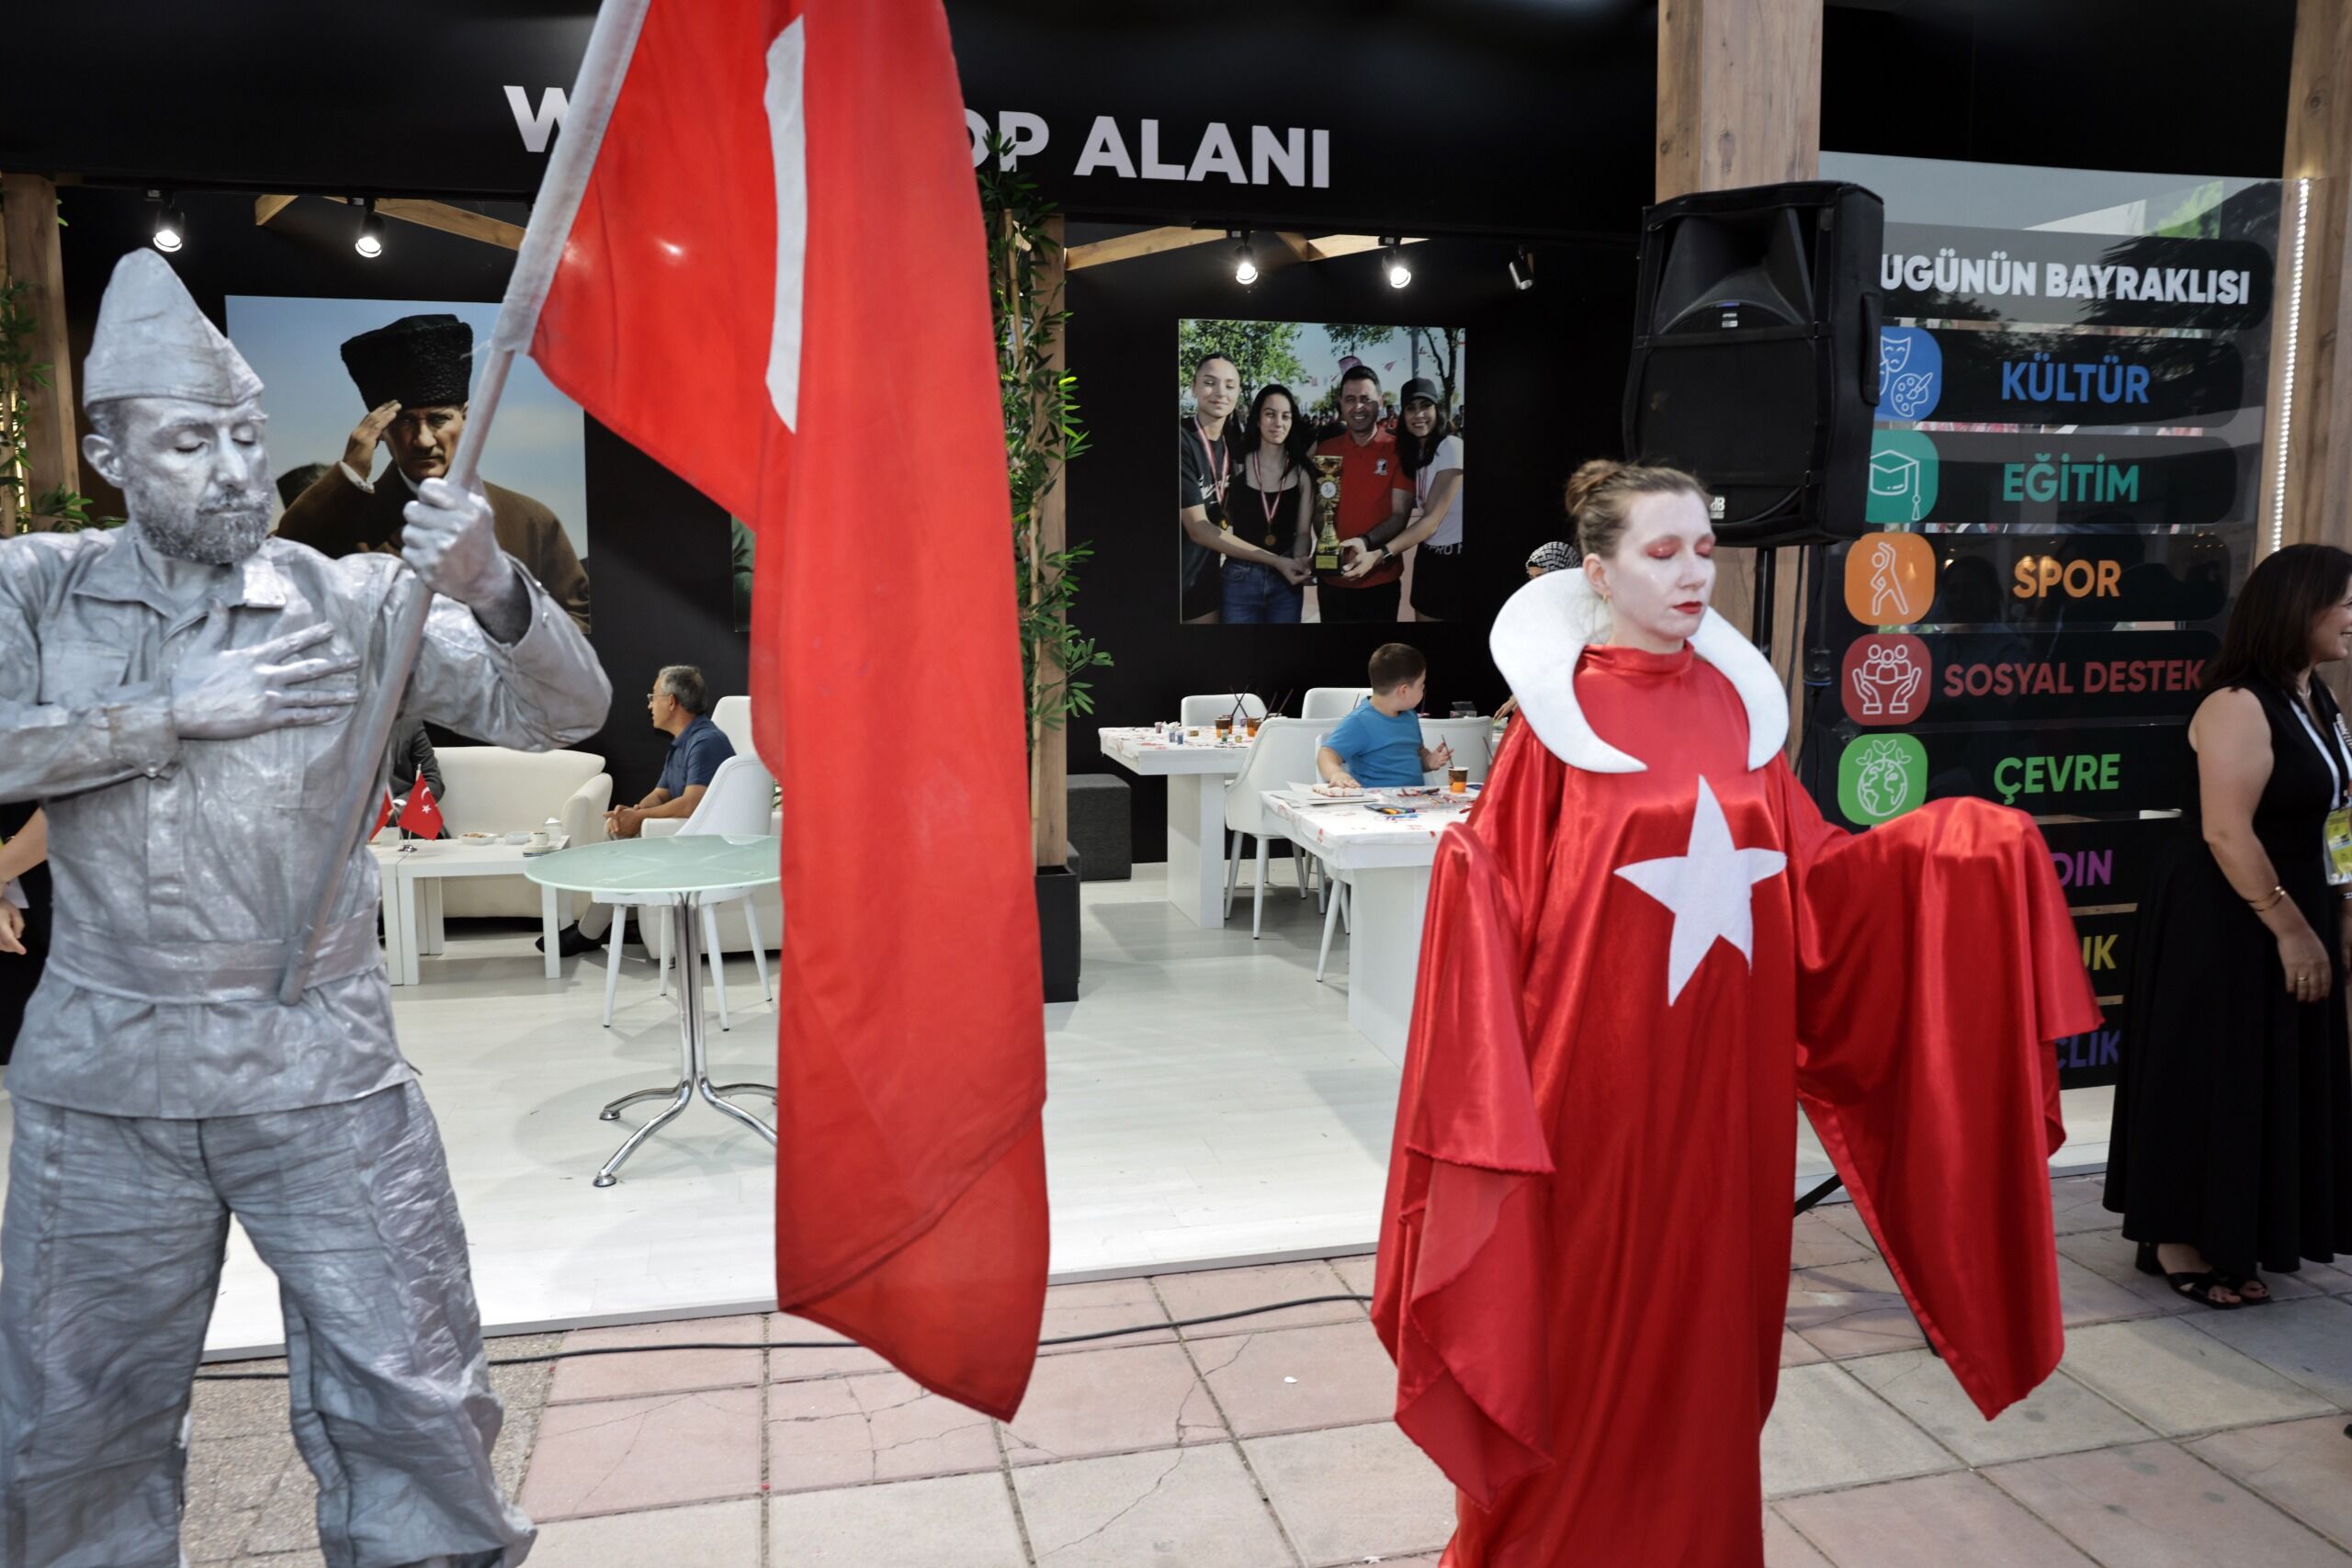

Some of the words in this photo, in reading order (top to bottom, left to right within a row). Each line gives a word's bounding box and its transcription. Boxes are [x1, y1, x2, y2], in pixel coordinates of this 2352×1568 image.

[1073, 115, 1330, 188] ALANI
[1880, 247, 2037, 297] UGÜNÜN
[2045, 262, 2251, 305] BAYRAKLISI
[2001, 352, 2150, 404] KÜLTÜR
[2003, 453, 2140, 503] EĞİTİM
[2012, 558, 2122, 599] SPOR
[1943, 662, 2073, 697] SOSYAL
[2084, 658, 2205, 693] DESTEK
[1994, 753, 2121, 805] ÇEVRE
